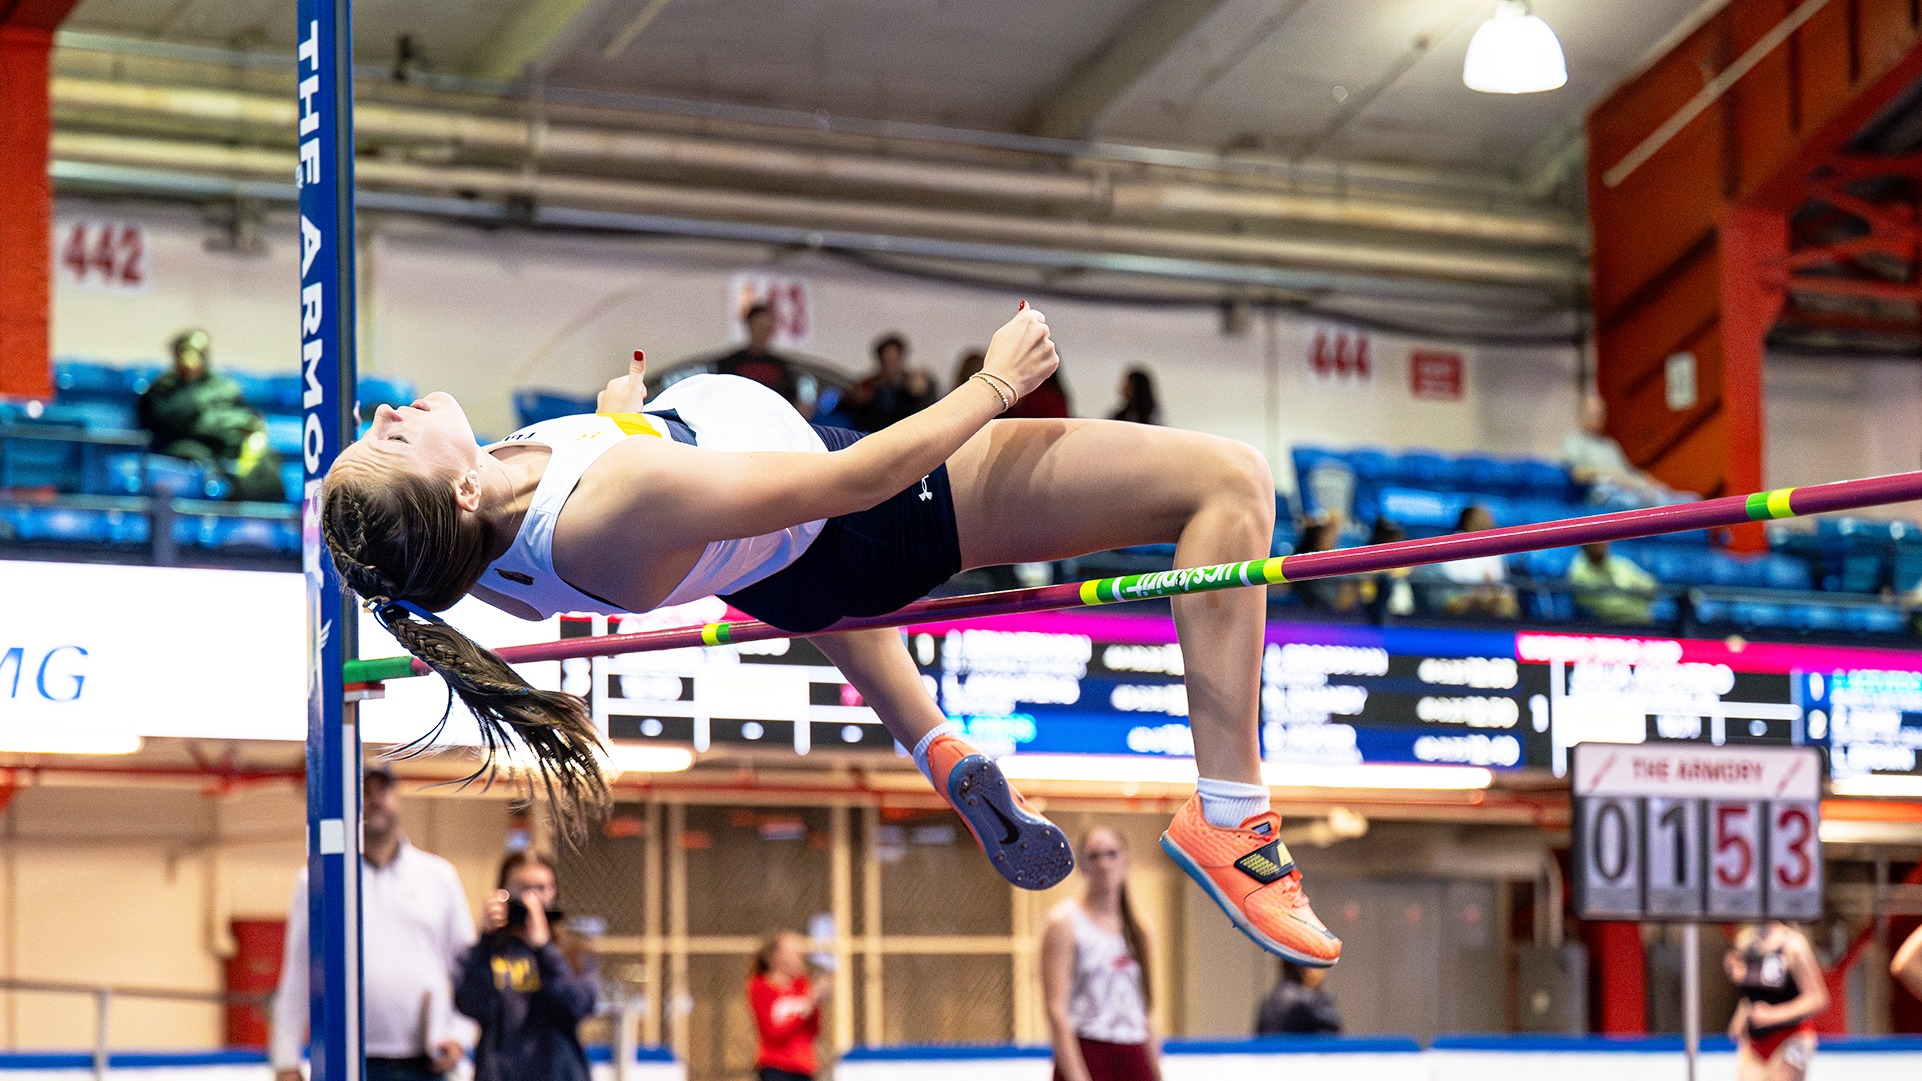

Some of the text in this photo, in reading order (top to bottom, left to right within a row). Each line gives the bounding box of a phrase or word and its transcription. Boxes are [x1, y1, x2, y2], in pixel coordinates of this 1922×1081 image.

[298, 19, 321, 185] THE
[61, 223, 145, 286] 442
[1632, 758, 1766, 784] THE ARMORY
